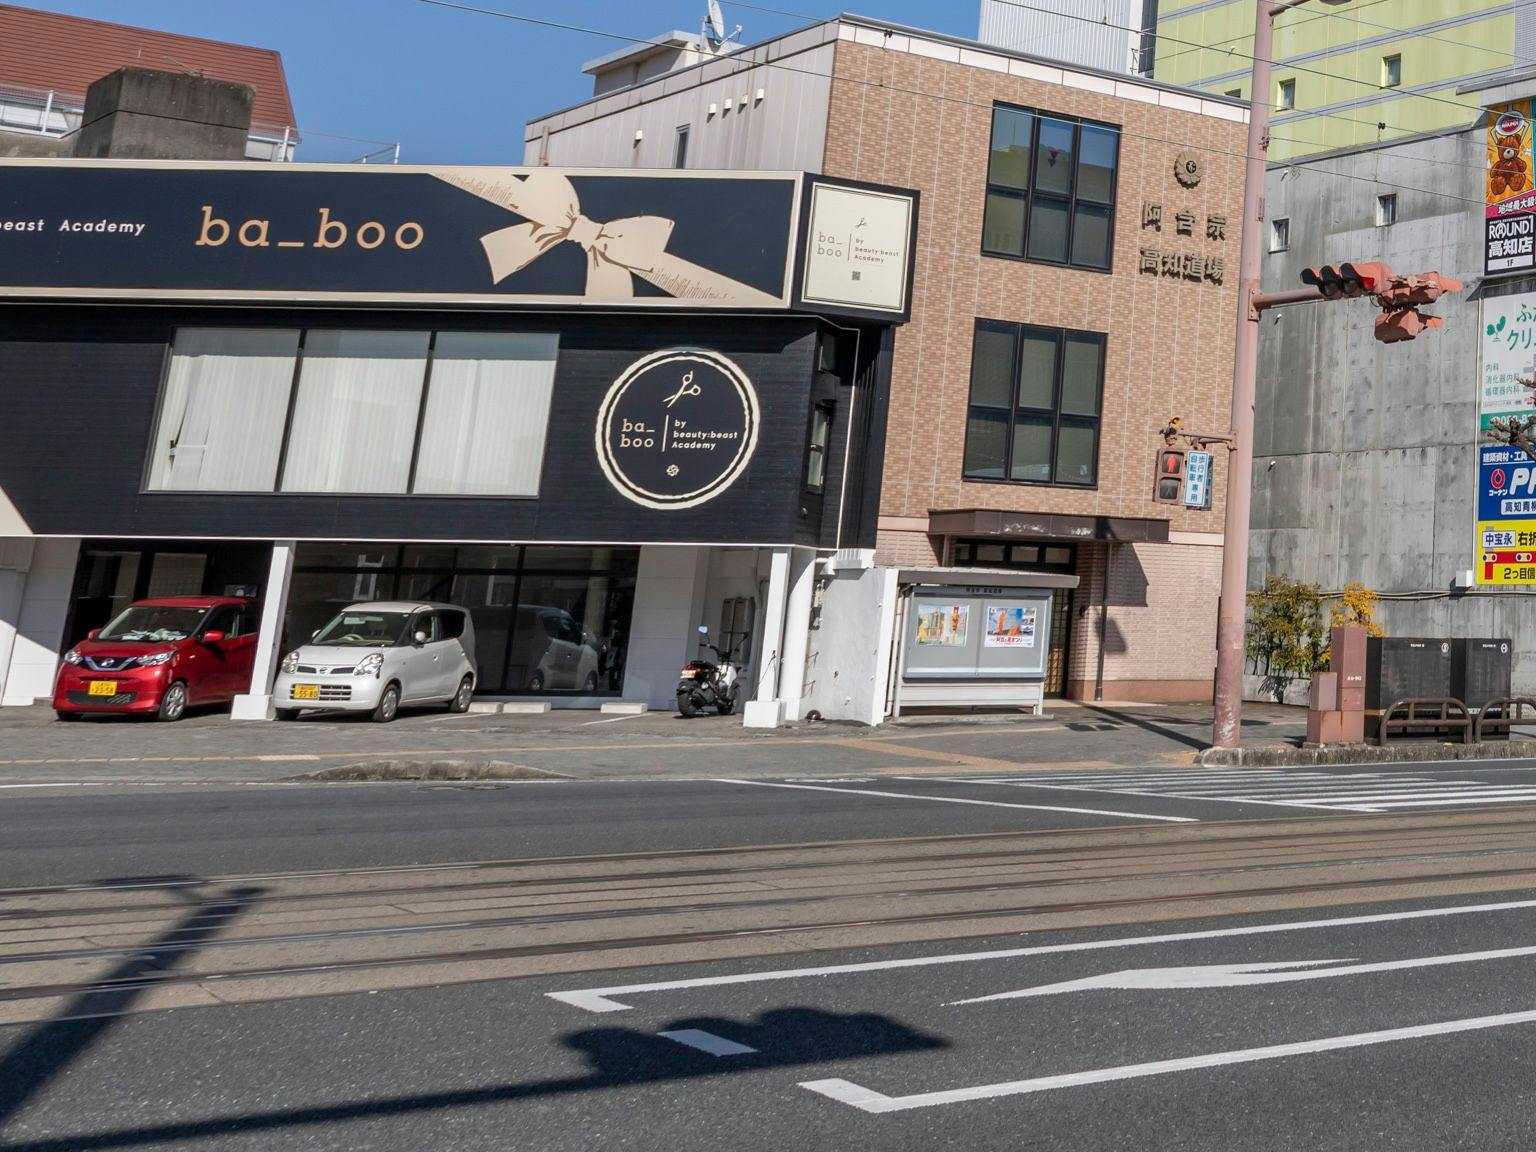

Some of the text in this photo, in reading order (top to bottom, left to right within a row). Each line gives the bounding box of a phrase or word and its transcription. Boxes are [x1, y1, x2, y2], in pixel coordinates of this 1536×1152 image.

[0, 218, 146, 236] east Academy
[195, 206, 425, 249] ba_boo
[817, 244, 842, 257] boo
[1488, 236, 1533, 258] 高知店
[854, 254, 885, 263] Academy
[1140, 247, 1223, 285] 高知道場
[1486, 363, 1498, 372] 内科
[674, 419, 687, 429] by
[620, 434, 654, 448] boo
[673, 430, 738, 441] beauty:beast
[672, 441, 716, 451] Academy
[1488, 489, 1508, 497] コーナン
[1485, 533, 1512, 546] 中宝永
